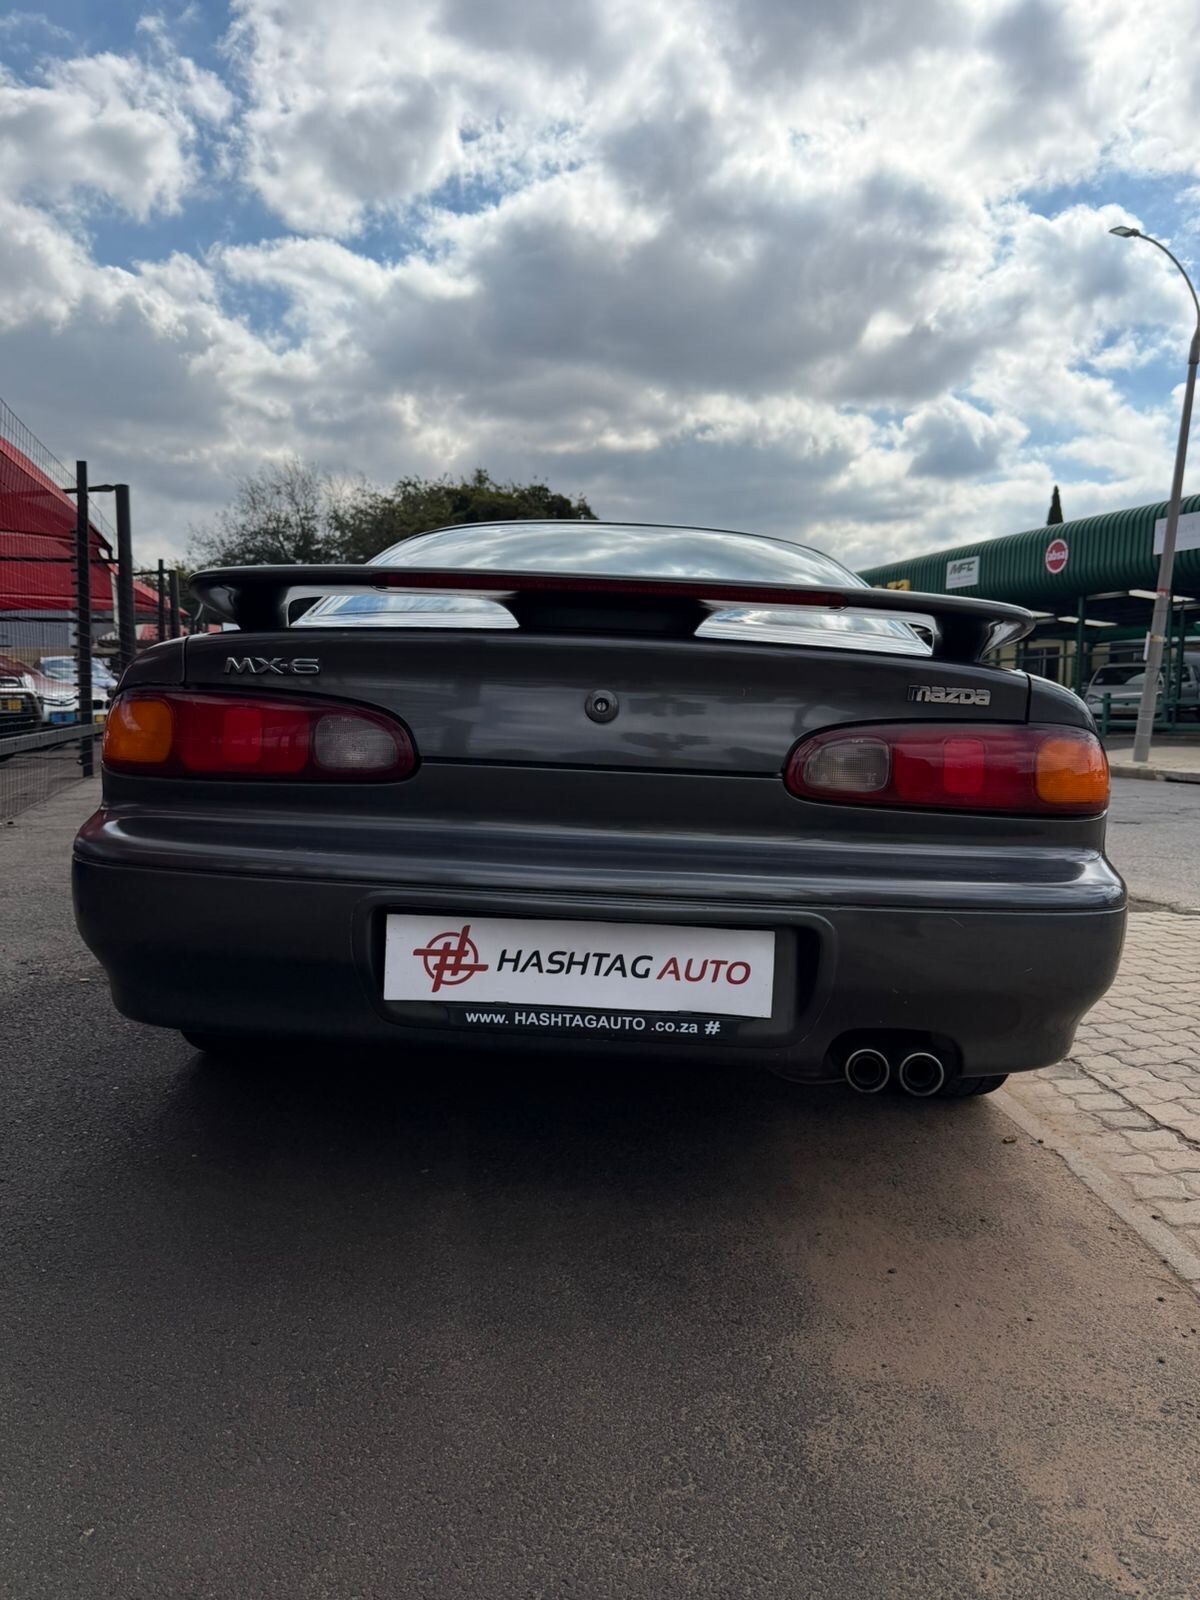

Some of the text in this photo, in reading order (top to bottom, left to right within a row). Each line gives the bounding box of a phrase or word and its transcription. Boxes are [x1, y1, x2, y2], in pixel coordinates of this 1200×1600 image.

[1047, 549, 1066, 562] absa
[949, 560, 976, 576] MFC
[224, 656, 320, 675] MX-6
[496, 949, 751, 985] HASHTAG AUTO
[465, 1012, 509, 1025] www.
[514, 1012, 646, 1030] HASHTAGAUTO
[650, 1019, 699, 1034] .co.za
